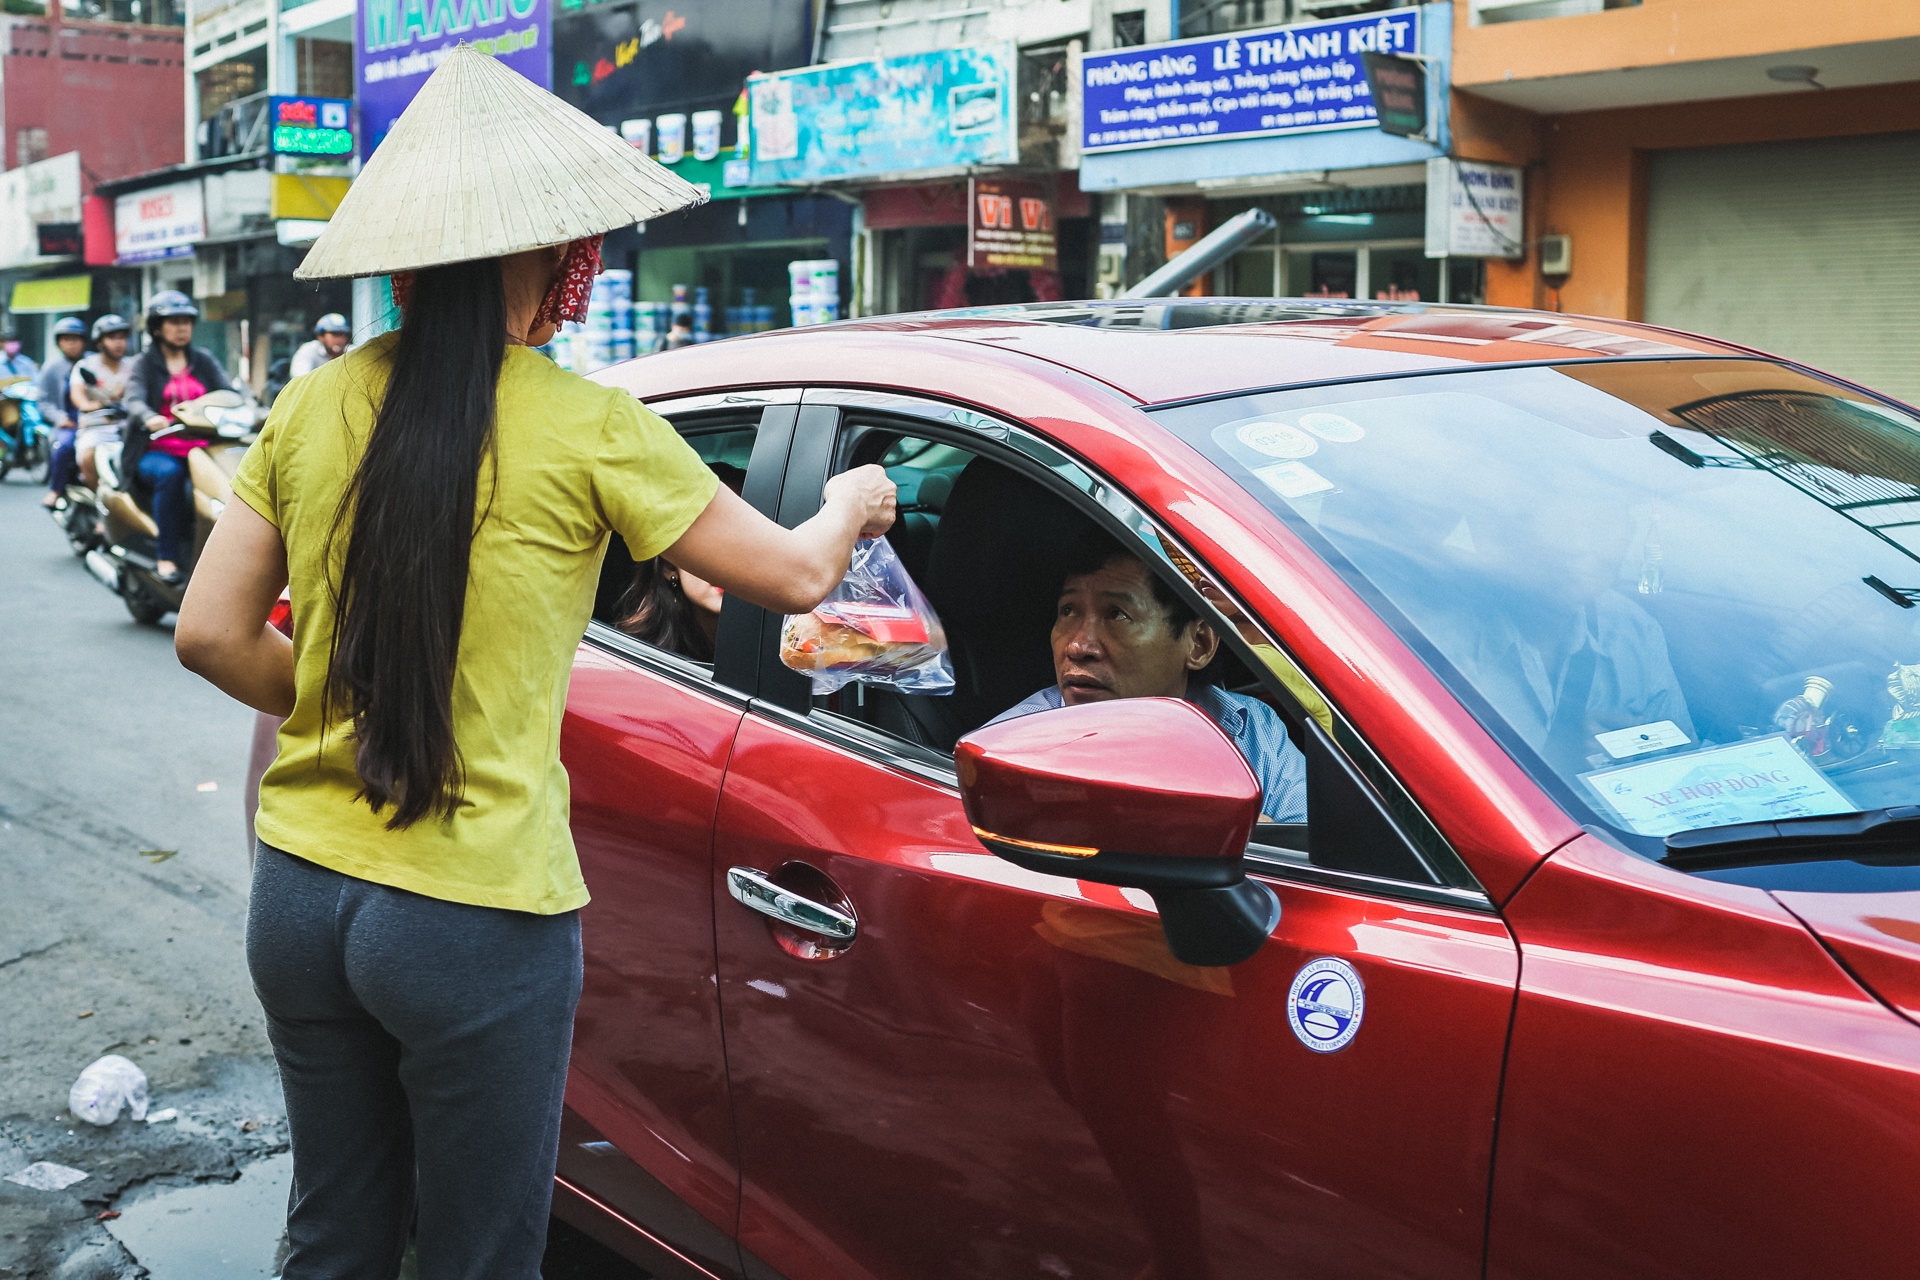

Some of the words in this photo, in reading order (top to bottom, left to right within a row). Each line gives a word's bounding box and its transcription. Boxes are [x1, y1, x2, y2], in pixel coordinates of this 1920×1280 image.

[1213, 38, 1241, 71] LÊ
[1245, 30, 1342, 67] THÀNH
[1348, 17, 1410, 54] KIỆT
[1086, 60, 1148, 88] PHÒNG
[1643, 790, 1679, 809] XE
[1677, 780, 1723, 800] HỢP
